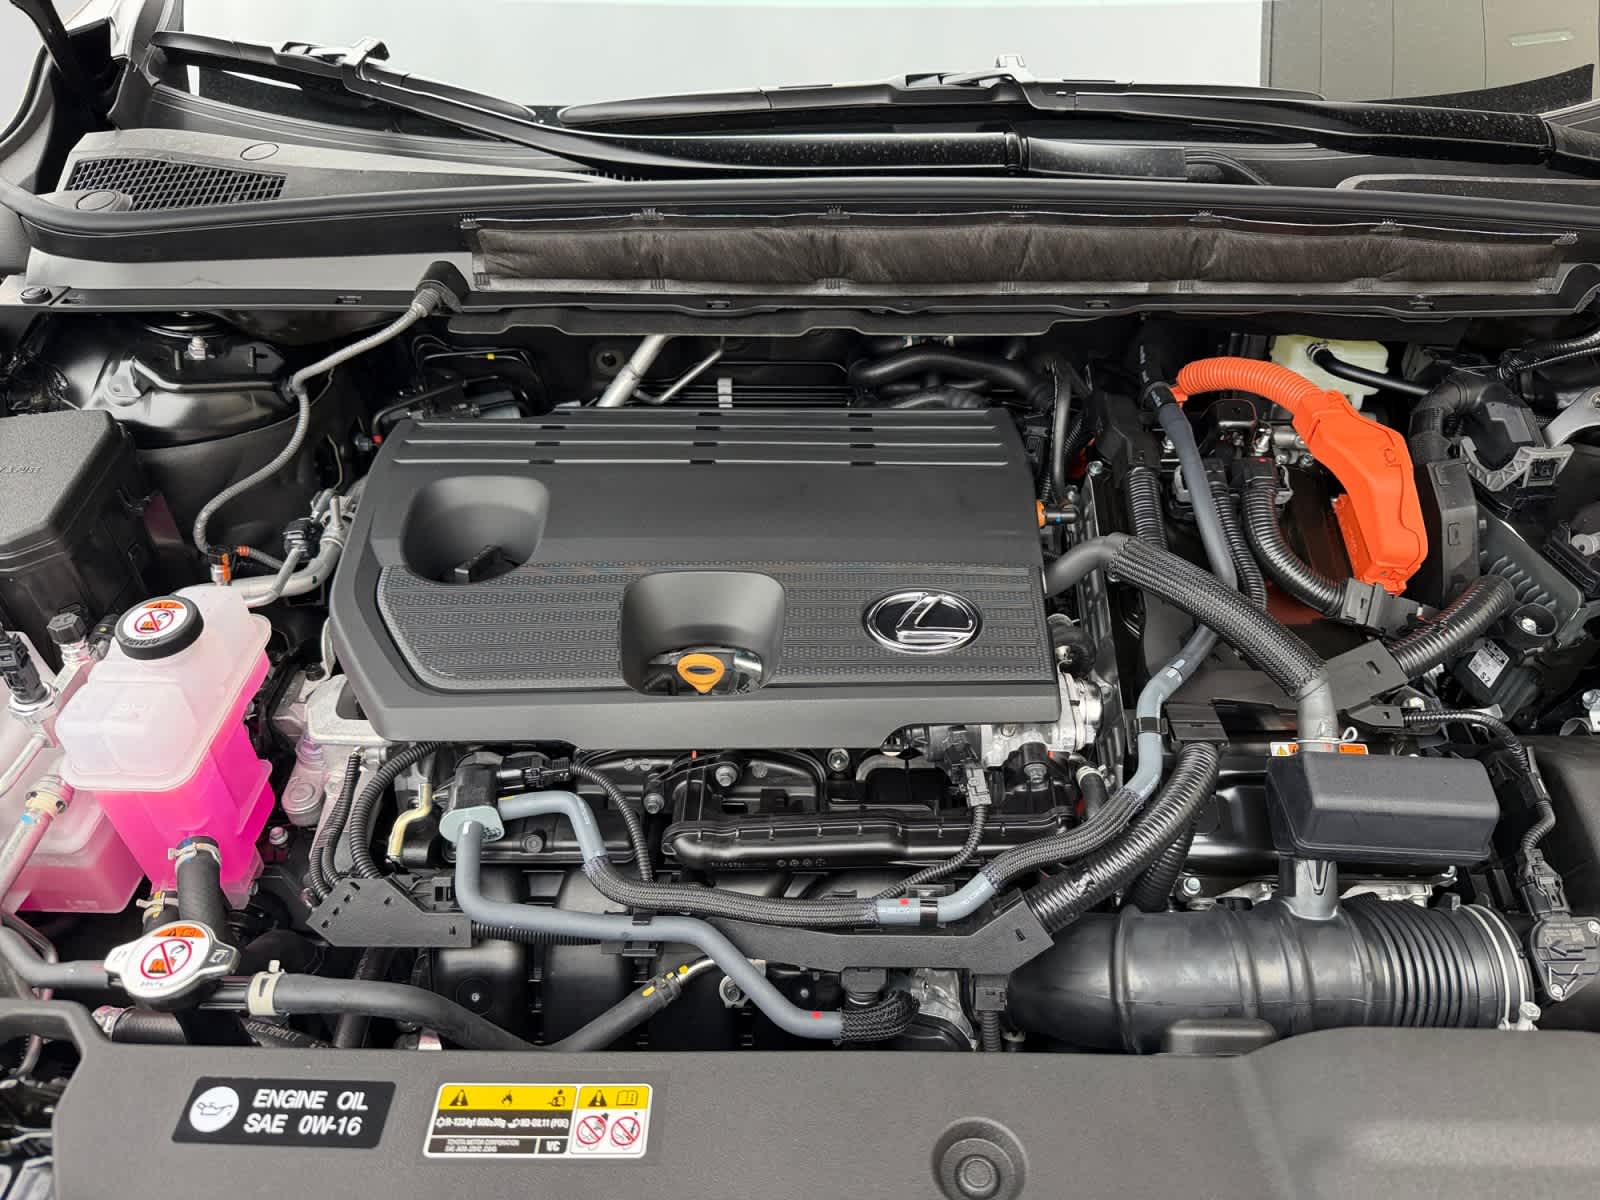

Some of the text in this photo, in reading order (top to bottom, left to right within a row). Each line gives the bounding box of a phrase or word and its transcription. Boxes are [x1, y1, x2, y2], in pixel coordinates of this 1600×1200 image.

[252, 1089, 369, 1111] ENGINE OIL
[243, 1113, 363, 1136] SAE 0W-16
[545, 1140, 561, 1152] VC
